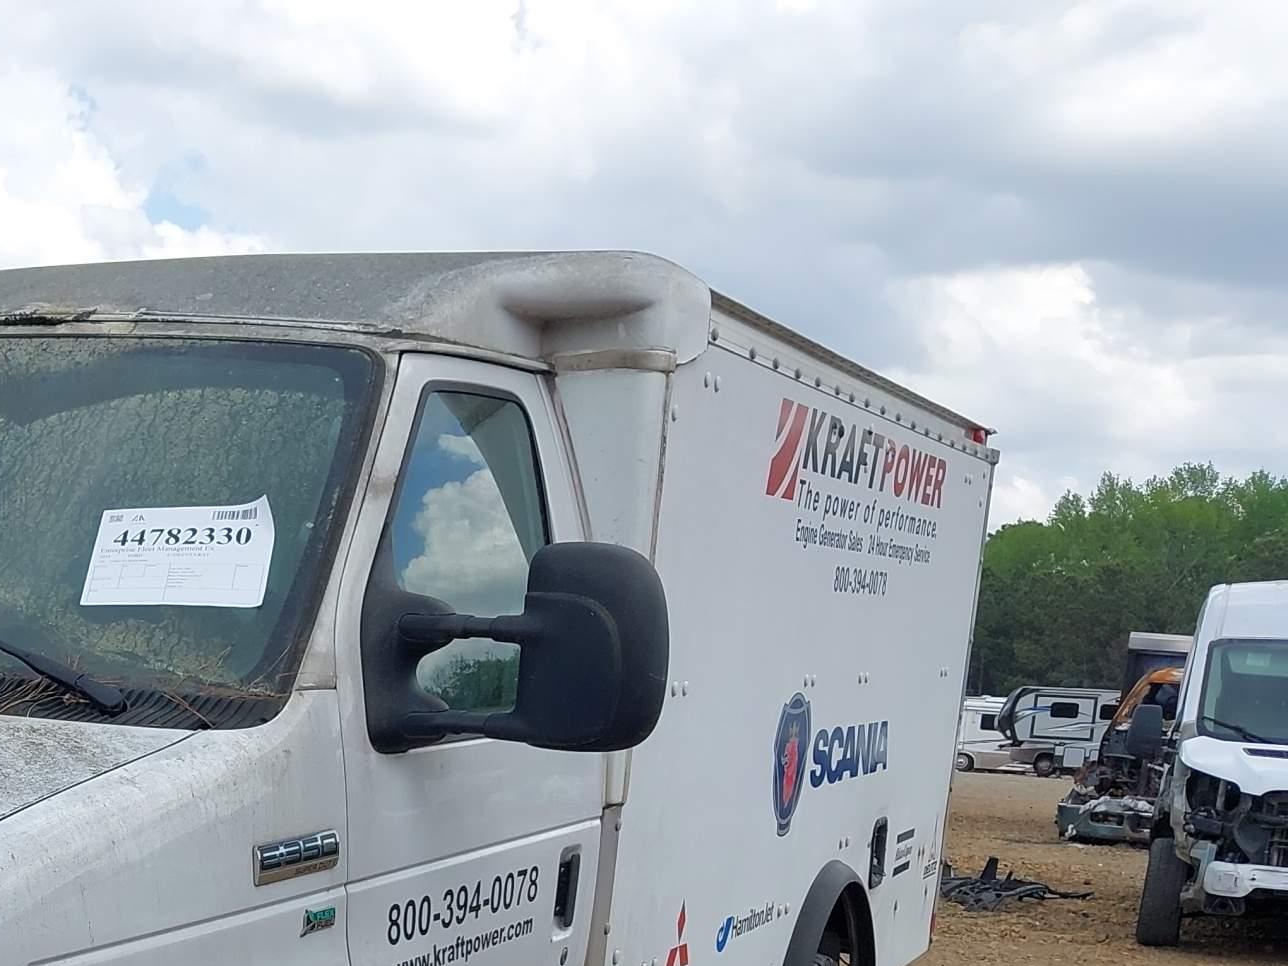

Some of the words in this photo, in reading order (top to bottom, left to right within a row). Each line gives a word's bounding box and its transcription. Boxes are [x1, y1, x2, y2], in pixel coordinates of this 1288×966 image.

[802, 407, 947, 508] KRAFTPOWER
[797, 479, 820, 513] The
[823, 494, 861, 521] power
[864, 499, 878, 524] of
[113, 527, 252, 547] 44782330
[795, 518, 818, 549] Engine
[818, 523, 848, 551] Generator
[847, 529, 864, 553] Sales
[875, 534, 889, 557] Hour
[888, 538, 913, 566] Emergency
[913, 543, 931, 563] Service
[833, 566, 888, 596] 800-394-0078
[810, 720, 889, 788] SCANIA
[387, 865, 539, 946] 800-394-0078
[731, 901, 774, 939] HamiltonJet
